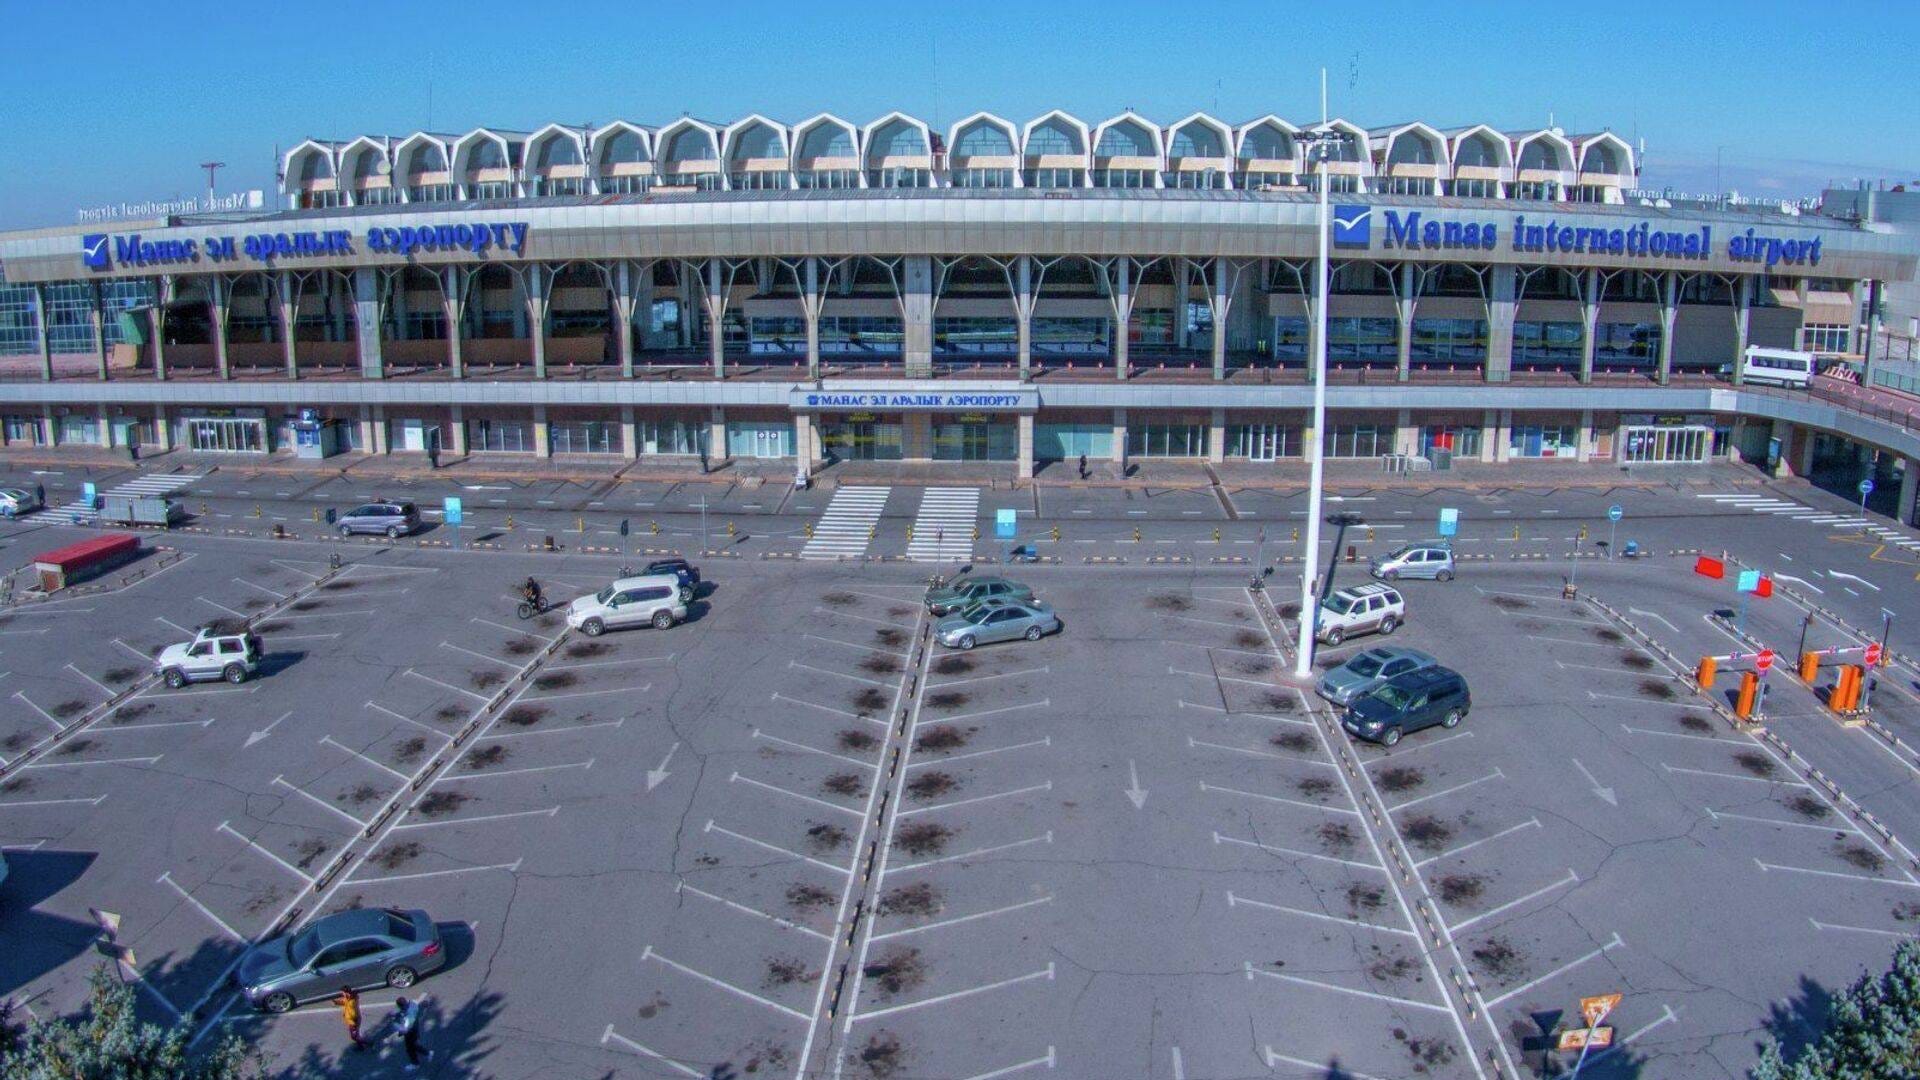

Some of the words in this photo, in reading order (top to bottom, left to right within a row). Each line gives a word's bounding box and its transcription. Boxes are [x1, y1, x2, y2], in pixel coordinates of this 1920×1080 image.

[116, 235, 194, 266] Манас
[205, 235, 234, 259] эл
[244, 230, 351, 262] аралык
[367, 222, 528, 256] аэропорту
[1384, 210, 1497, 249] Manas
[1513, 217, 1712, 258] international
[1728, 228, 1822, 267] airport
[821, 394, 868, 406] МАНАС
[870, 394, 888, 406] ЭЛ
[891, 394, 943, 406] АРАЛЫК
[947, 394, 1021, 406] АЭРОПОРТУ
